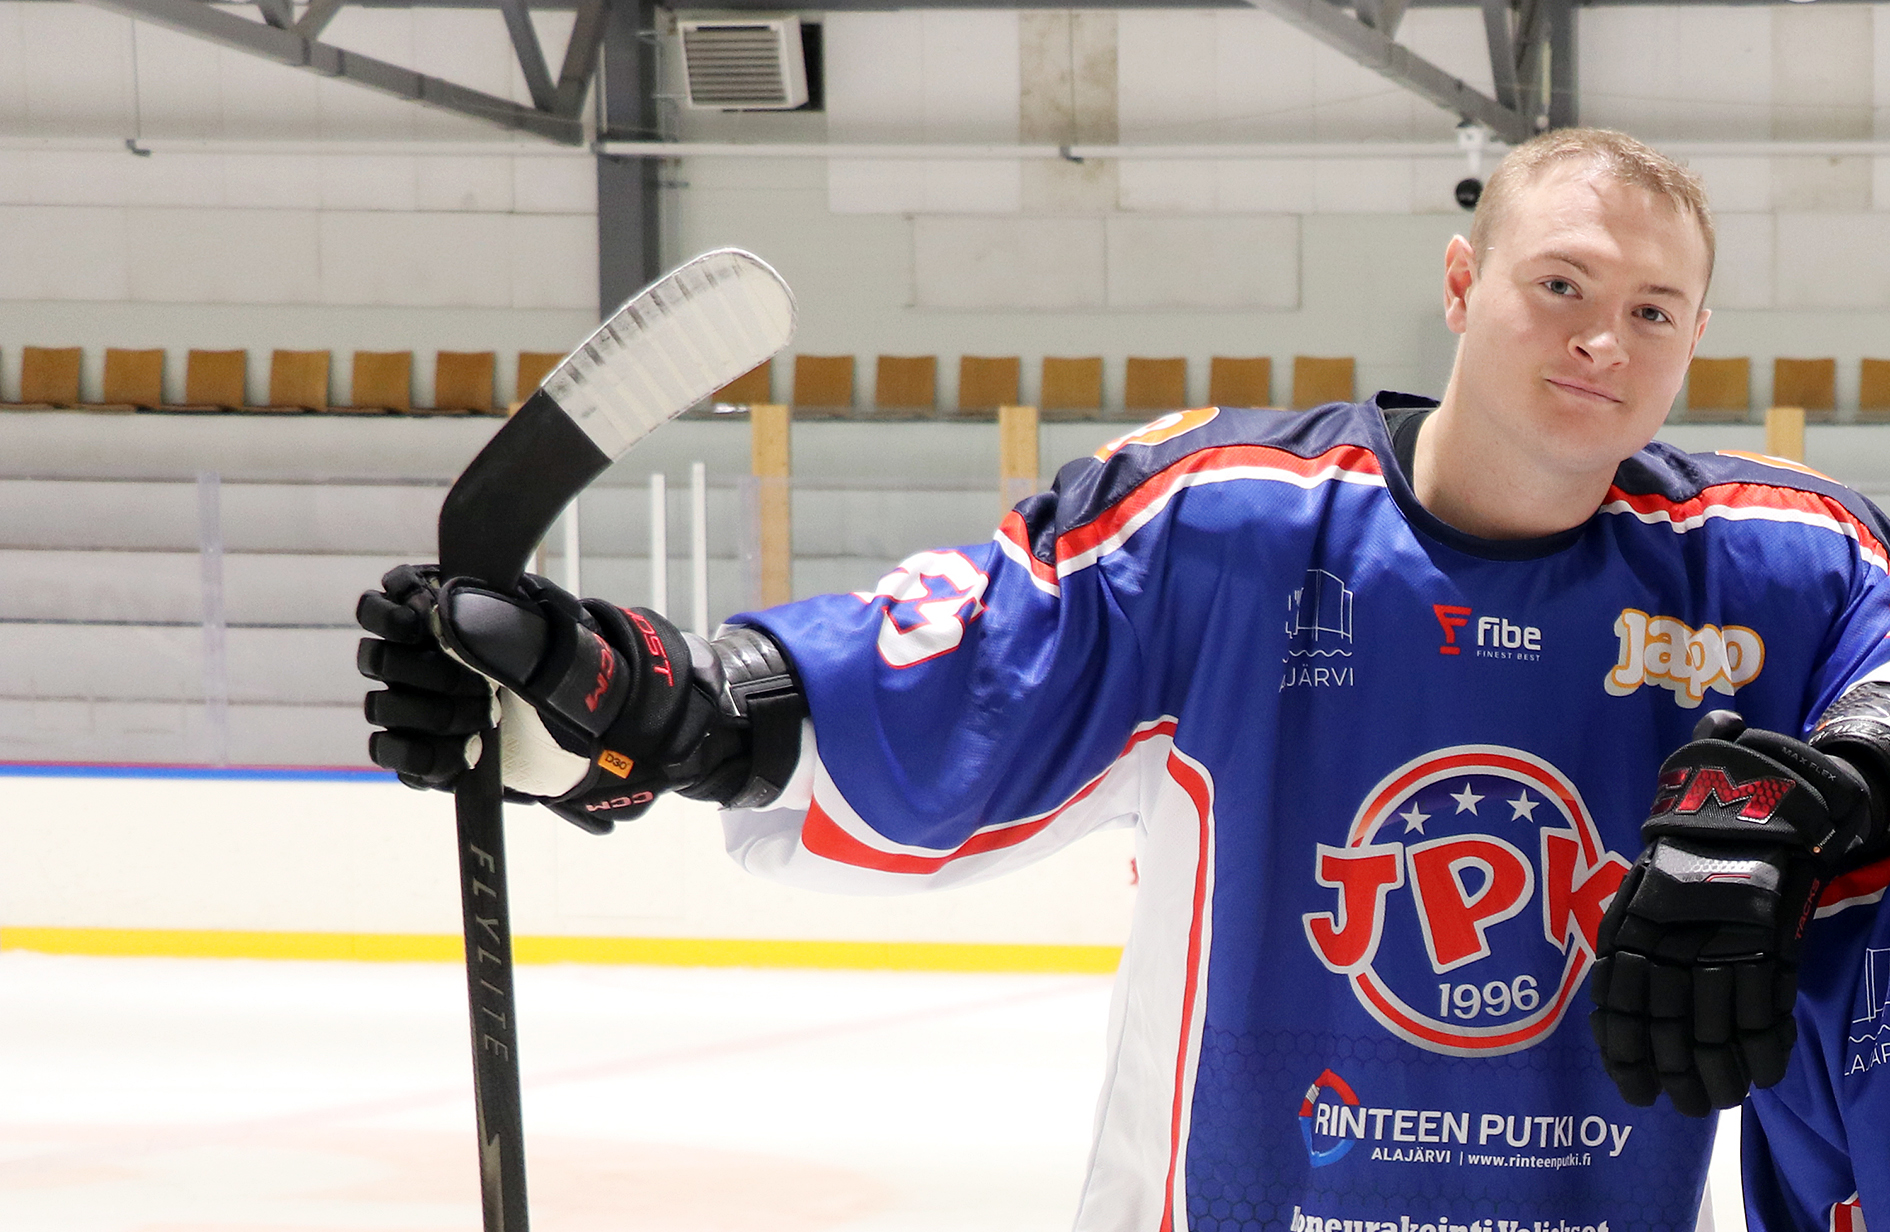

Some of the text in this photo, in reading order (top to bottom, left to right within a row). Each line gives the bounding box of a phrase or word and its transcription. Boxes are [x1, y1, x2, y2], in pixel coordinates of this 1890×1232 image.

[1477, 616, 1542, 651] Fibe
[1476, 650, 1542, 662] FINEST BEST
[1781, 747, 1836, 782] MAX FLEX
[585, 790, 654, 812] CCM
[1795, 878, 1820, 940] TACKS
[470, 842, 509, 1062] FLYLITE
[1438, 974, 1541, 1020] 1996
[1315, 1102, 1633, 1157] RINTEEN PUTKI Oy
[1370, 1146, 1592, 1170] ALAJÄRVI www.rinteenputki.fi
